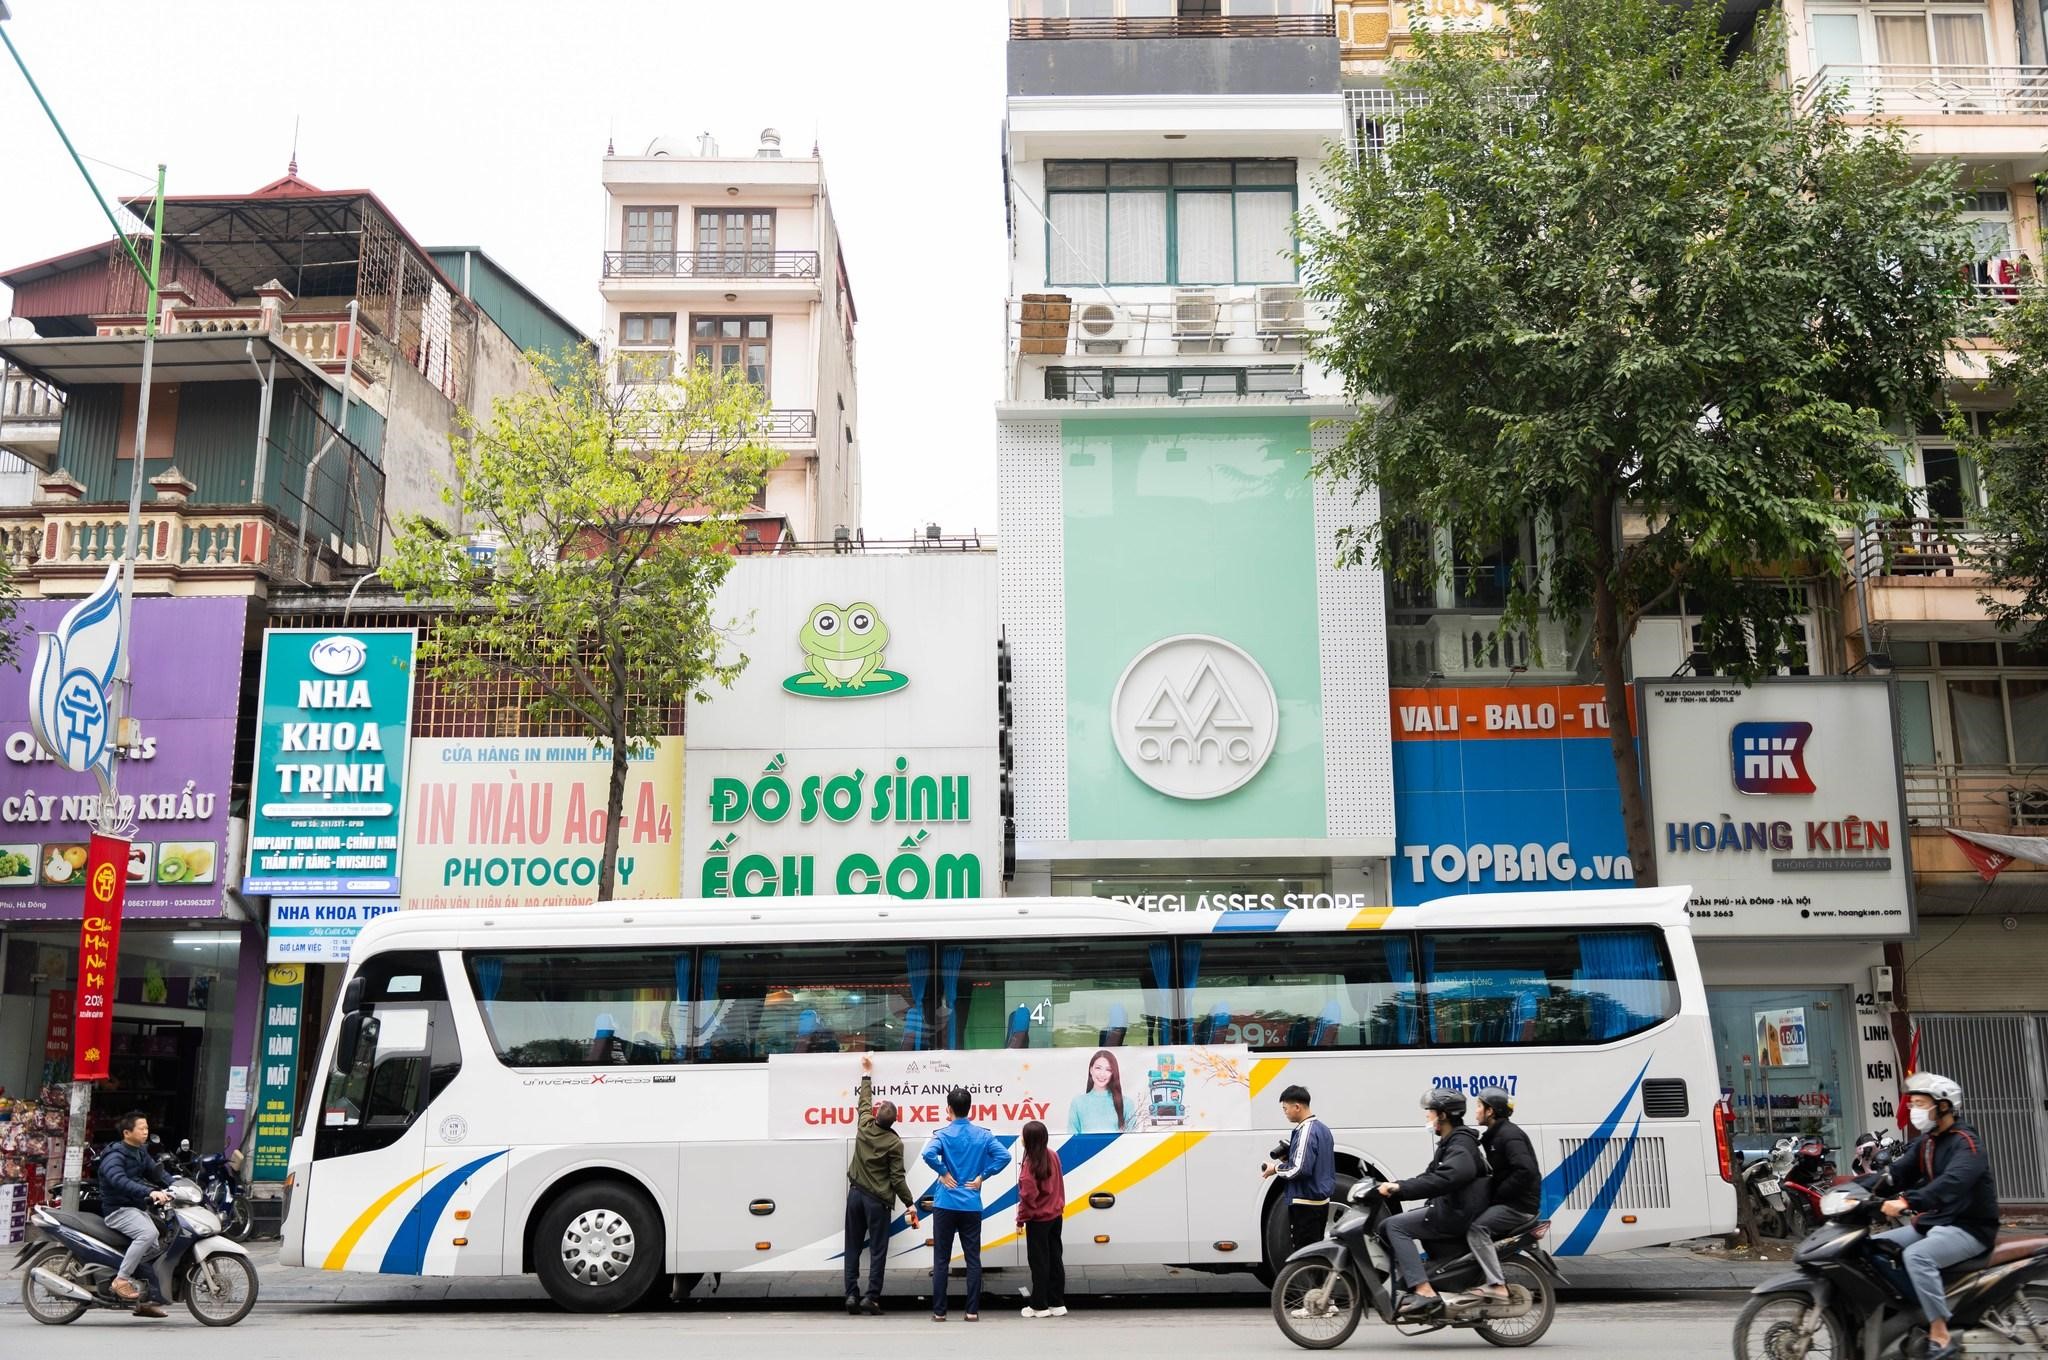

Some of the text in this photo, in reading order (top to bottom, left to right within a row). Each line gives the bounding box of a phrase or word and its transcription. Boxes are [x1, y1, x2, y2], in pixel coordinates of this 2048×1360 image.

[298, 680, 372, 709] NHA
[1399, 705, 1459, 732] VALI
[1485, 703, 1556, 731] BALO
[281, 722, 383, 751] KHOA
[1137, 735, 1253, 763] anna
[442, 742, 473, 762] CỬA
[525, 748, 537, 761] IN
[546, 747, 587, 761] MINH
[1743, 737, 1800, 779] HK
[275, 763, 386, 799] TRỊNH
[708, 751, 793, 824] ĐỒ
[800, 767, 866, 824] SƠ
[2, 789, 58, 822] CÂY
[138, 780, 216, 820] KHẨU
[416, 783, 457, 845] IN
[468, 768, 553, 845] MÀU
[253, 836, 293, 850] IMPLANT
[294, 836, 314, 850] NHA
[377, 836, 397, 850] NHA
[1666, 813, 1890, 853] HOÀNG KIÊN
[336, 855, 387, 869] INVISALIGN
[443, 857, 635, 887] PHOTOCOY
[701, 831, 815, 899] ẾCH
[1404, 842, 1634, 883] TOPBAG.vn
[278, 906, 309, 919] NHA
[315, 906, 357, 919] KHOA
[1283, 893, 1365, 911] STORE
[268, 1004, 297, 1026] RĂNG
[268, 1034, 293, 1056] HÀM
[1863, 1026, 1889, 1041] LINH
[266, 1064, 291, 1090] MẶT
[1867, 1060, 1892, 1082] KIỆN
[854, 1086, 886, 1096] KNH
[890, 1081, 919, 1096] MẮT
[984, 1084, 1003, 1097] trợ
[909, 1105, 940, 1123] XE
[1872, 1096, 1894, 1118] SỬA
